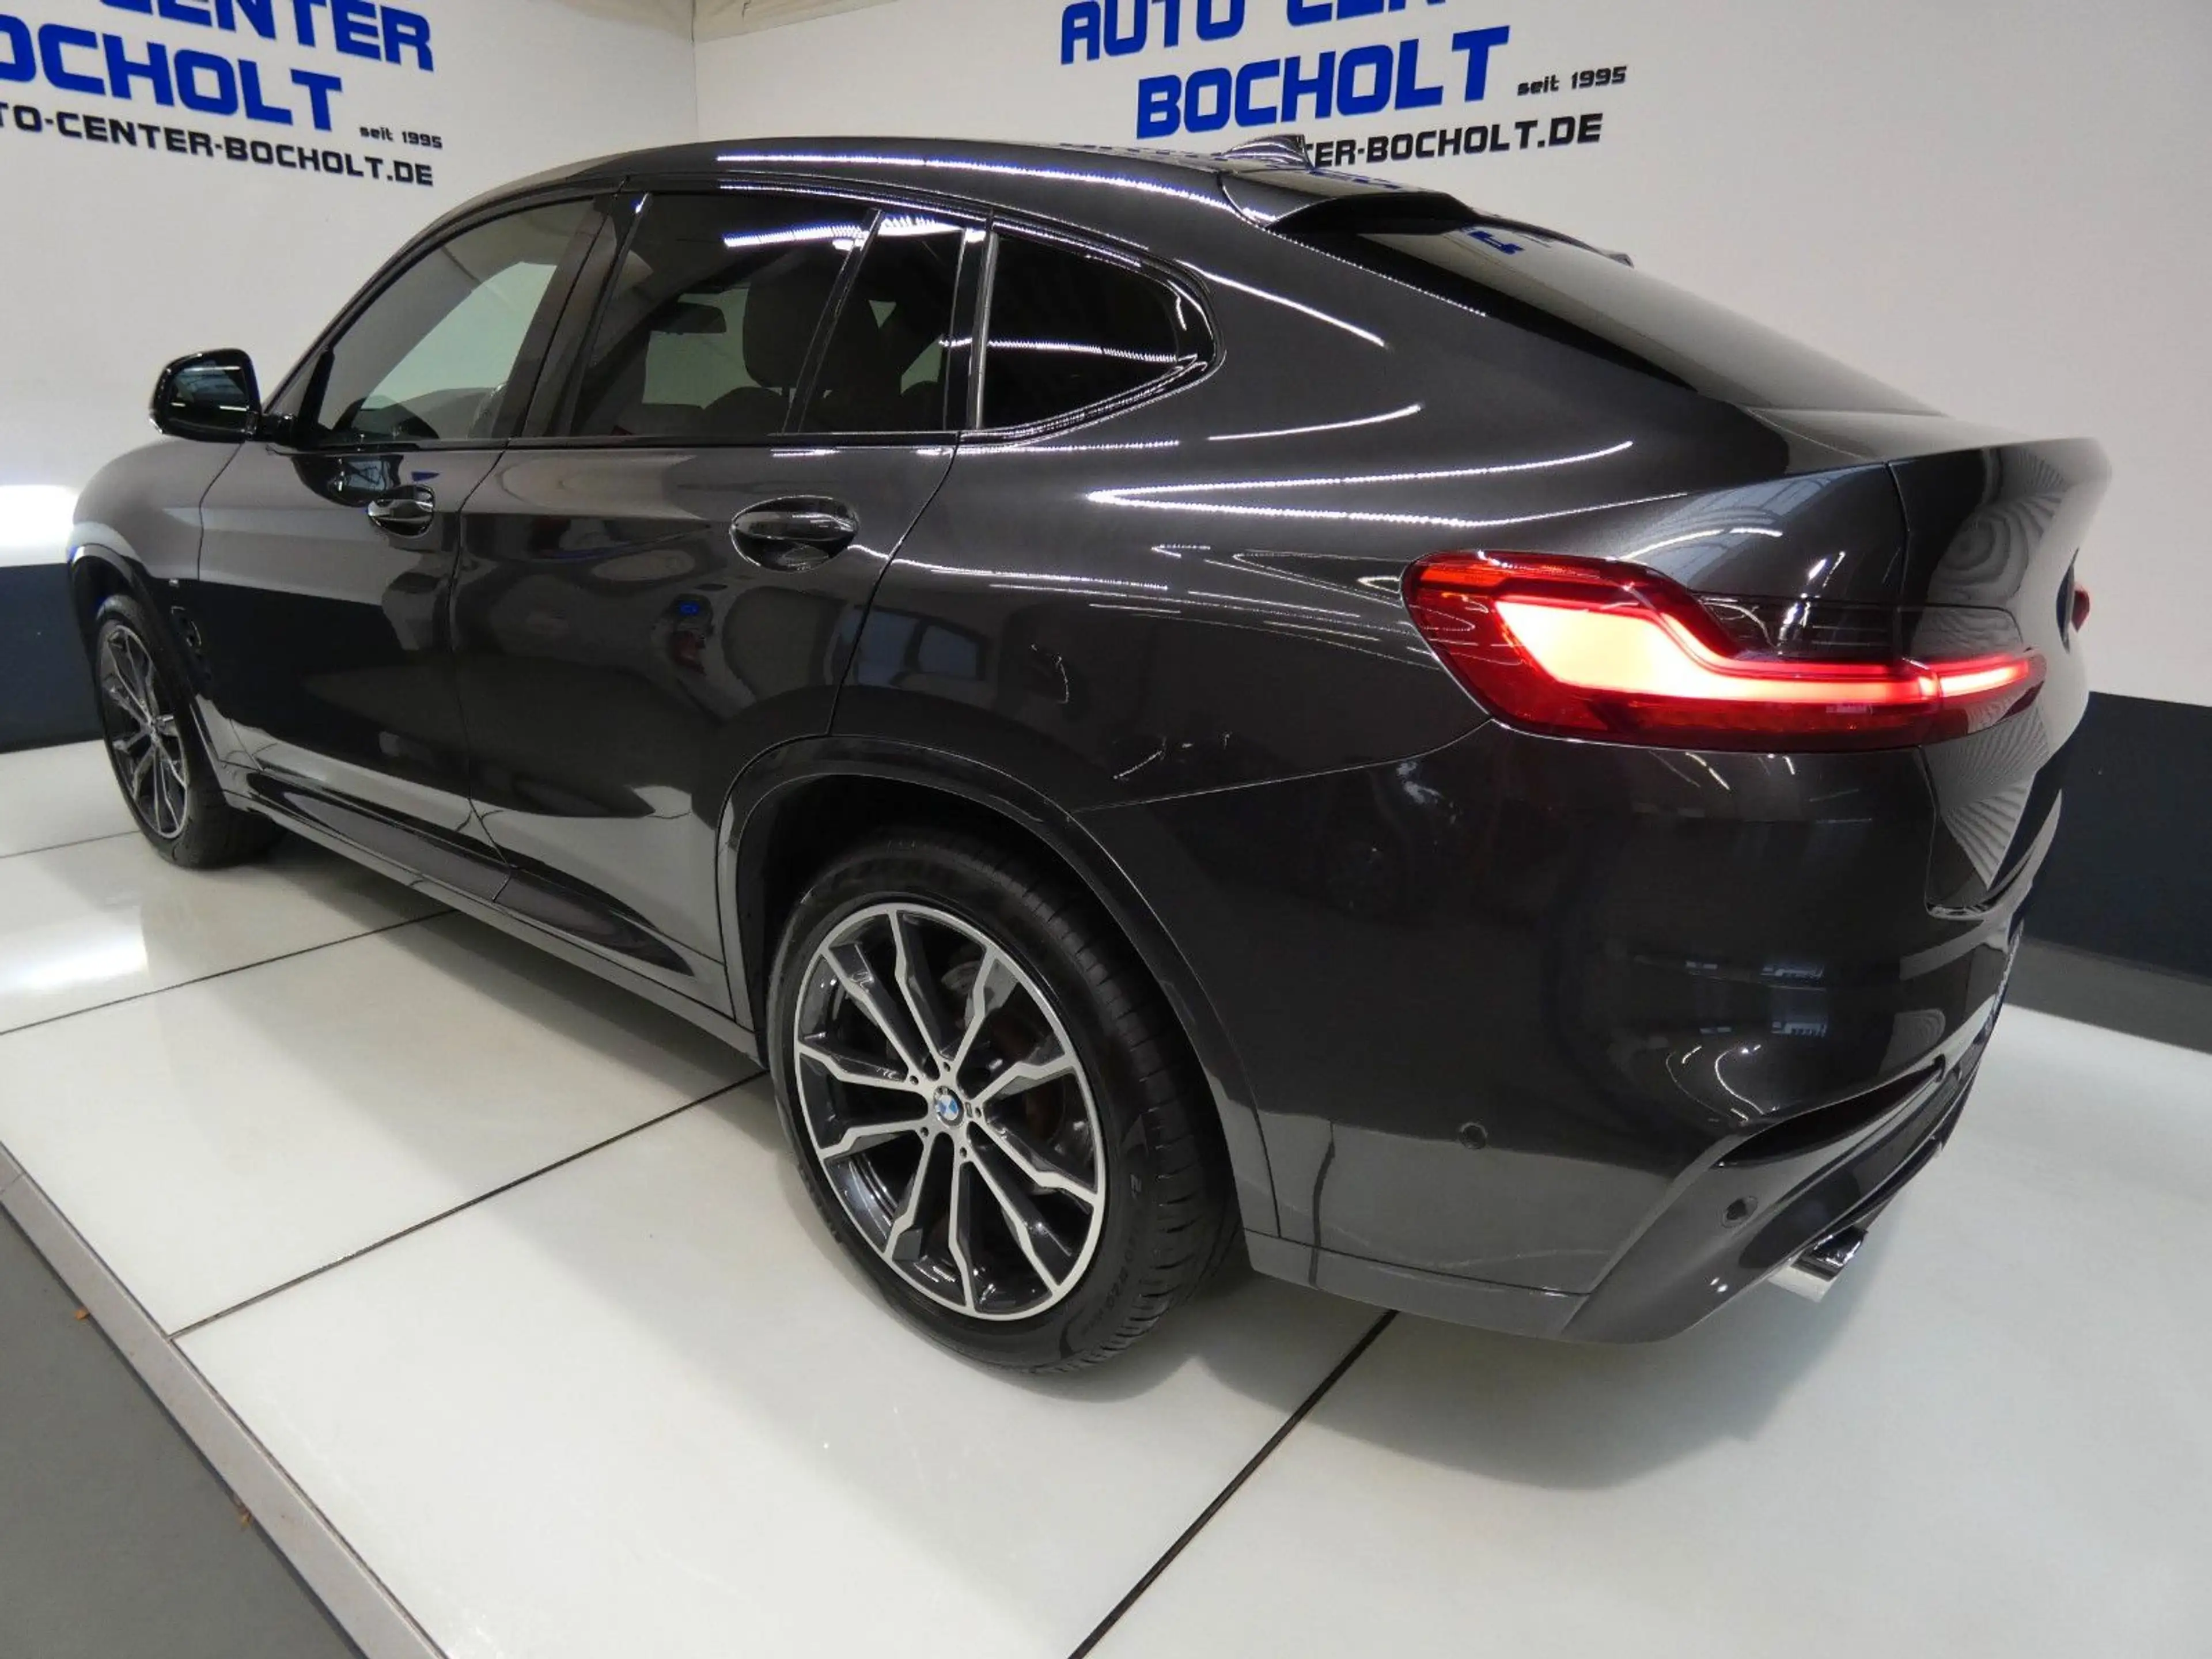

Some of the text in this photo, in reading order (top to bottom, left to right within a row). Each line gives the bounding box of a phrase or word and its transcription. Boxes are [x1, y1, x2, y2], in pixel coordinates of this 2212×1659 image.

[1060, 0, 1245, 65] AUTO
[1137, 25, 1627, 139] BOCHOLT seit 1995
[359, 126, 393, 142] seit
[402, 131, 443, 149] 1995
